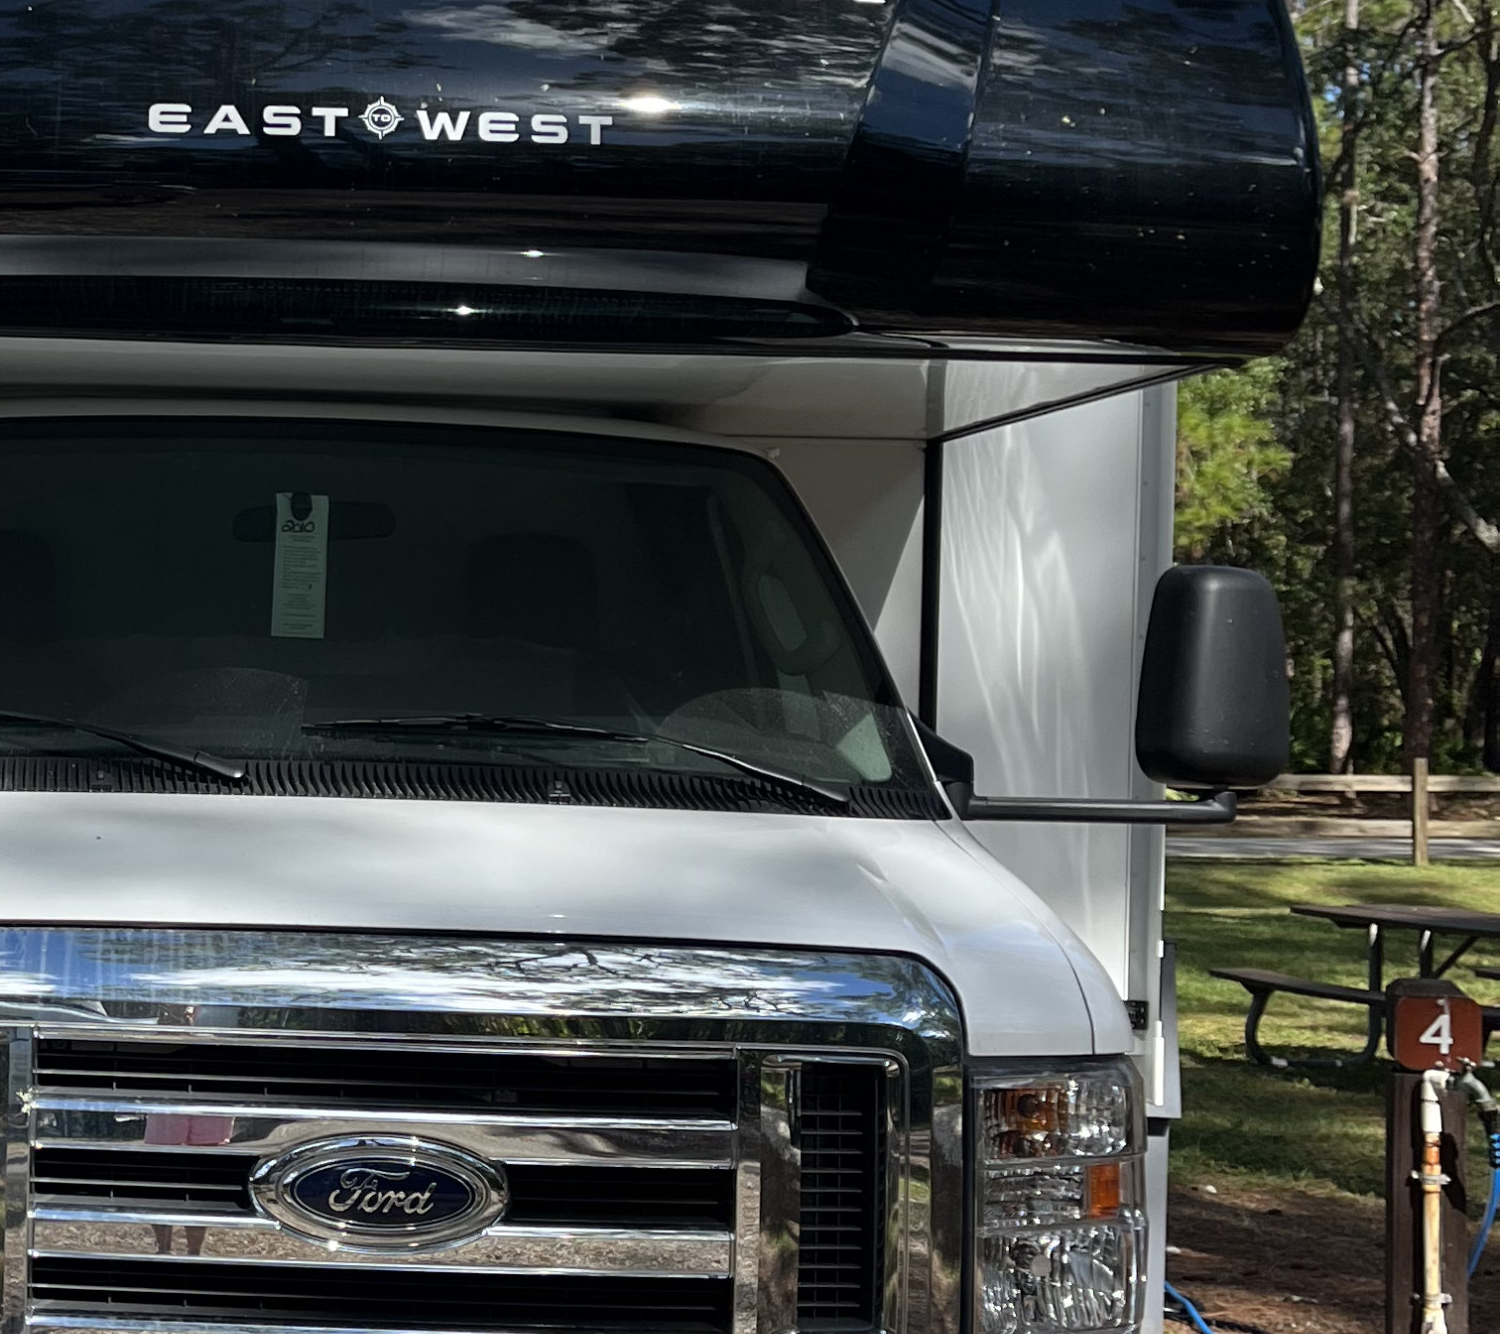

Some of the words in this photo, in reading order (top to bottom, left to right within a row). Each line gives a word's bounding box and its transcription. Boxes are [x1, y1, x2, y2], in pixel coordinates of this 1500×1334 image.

[147, 102, 350, 137] EAST
[371, 113, 392, 123] TO
[415, 108, 615, 146] WEST
[1418, 1013, 1454, 1055] 4
[328, 1166, 438, 1215] Ford
